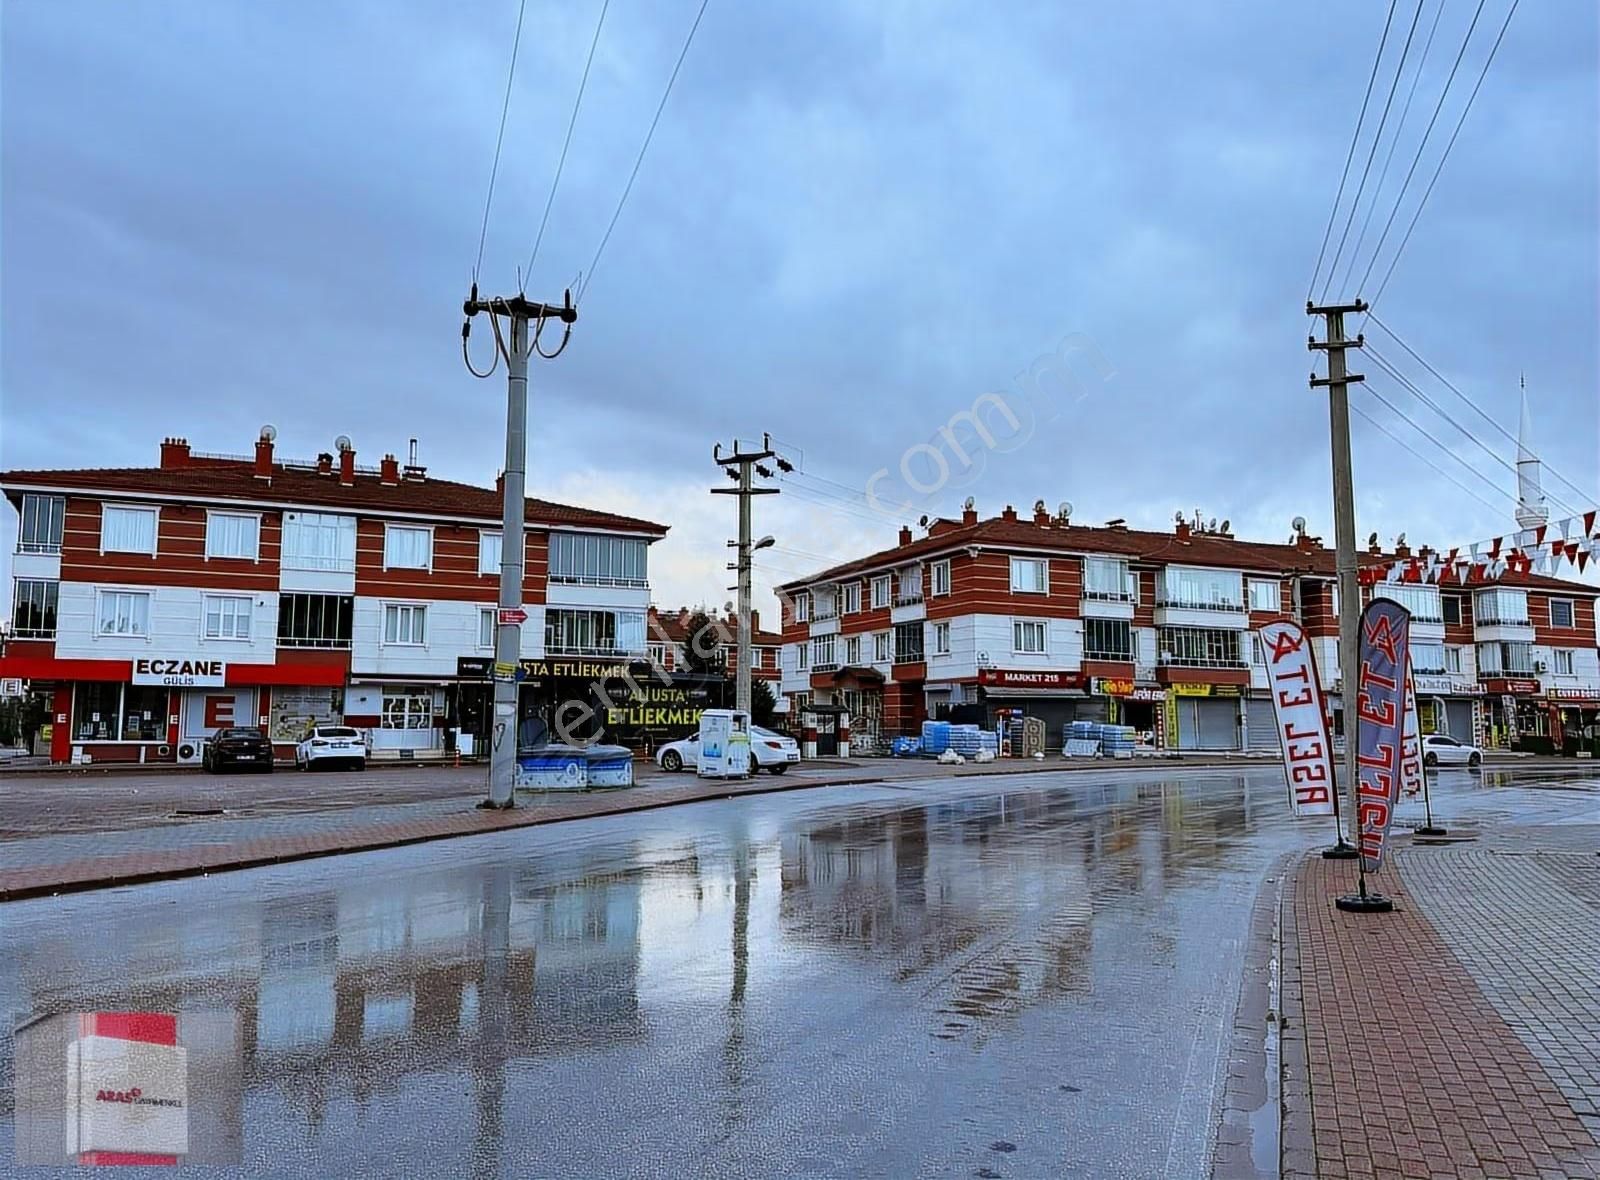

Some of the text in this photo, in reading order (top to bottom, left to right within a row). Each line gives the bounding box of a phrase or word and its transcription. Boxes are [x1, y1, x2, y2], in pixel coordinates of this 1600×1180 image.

[136, 658, 223, 676] ECZANE
[553, 660, 631, 677] ETLİEKMEK
[1005, 672, 1042, 682] MARKET
[1044, 674, 1060, 683] 215
[651, 688, 686, 702] USTA
[57, 713, 67, 723] E
[204, 695, 236, 729] E
[607, 704, 704, 725] ETLİEKMEK
[170, 714, 178, 725] E
[260, 715, 268, 725] E
